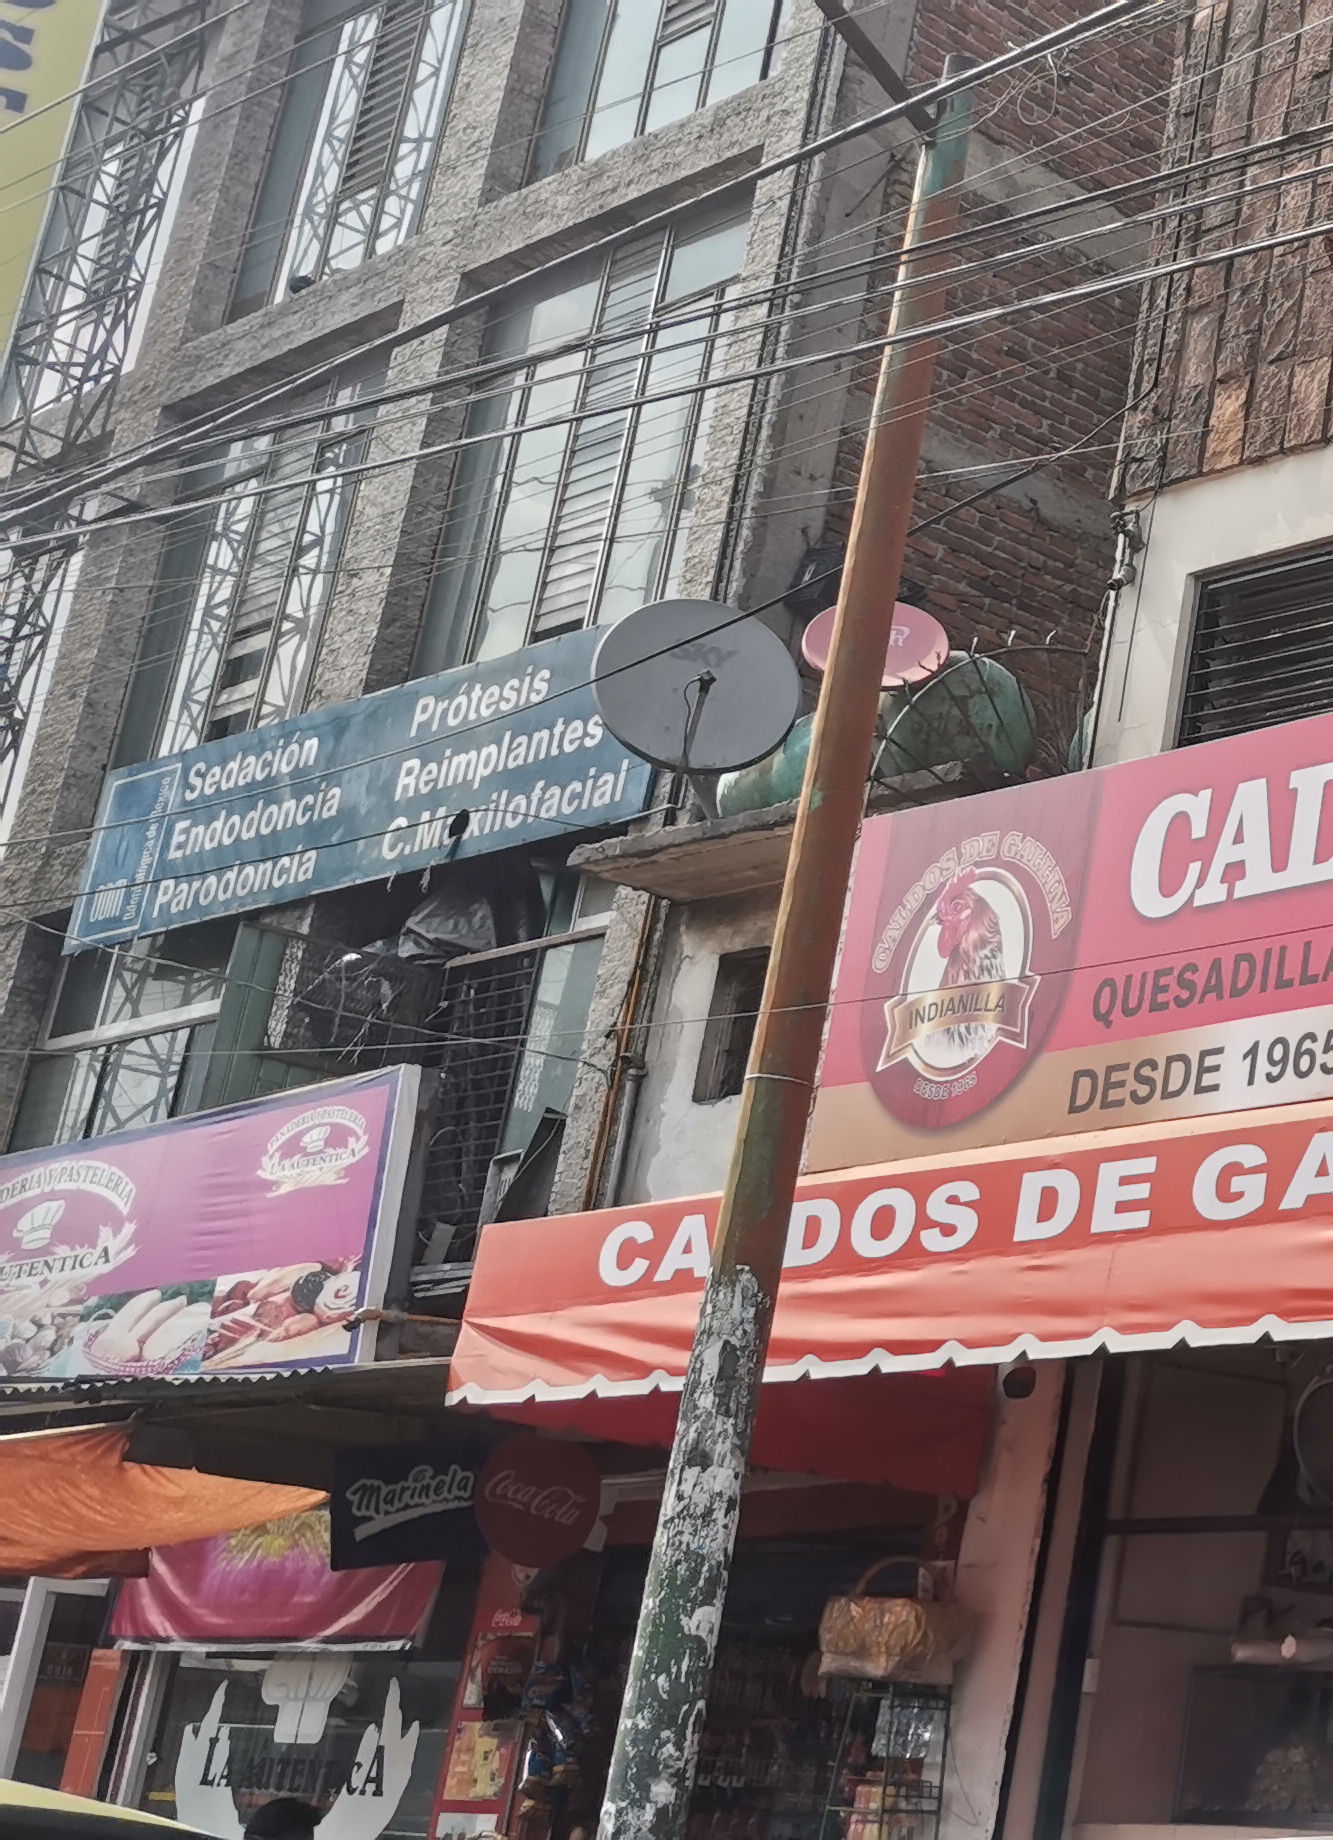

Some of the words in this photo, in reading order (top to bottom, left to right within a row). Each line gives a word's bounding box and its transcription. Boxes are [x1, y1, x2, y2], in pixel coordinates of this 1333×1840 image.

[409, 664, 552, 738] Prótesis
[184, 731, 319, 802] Sedación
[394, 712, 604, 802] Reimplantes
[167, 781, 342, 861] Endodoncia
[381, 757, 628, 860] C.Mxilofacial
[151, 844, 318, 919] Parodoncia
[871, 847, 958, 974] CALDOS
[960, 830, 1001, 867] DE
[1000, 830, 1072, 940] GALLINA
[908, 993, 1006, 1030] INDIANILLA
[1067, 1046, 1225, 1115] DESDE
[0, 1170, 43, 1204] DERIA
[58, 1164, 135, 1207] PASTELERIA
[598, 1181, 981, 1289] CADOS
[1013, 1156, 1158, 1242] DE
[0, 1245, 111, 1281] UTENTICA
[345, 1464, 476, 1518] Marinela
